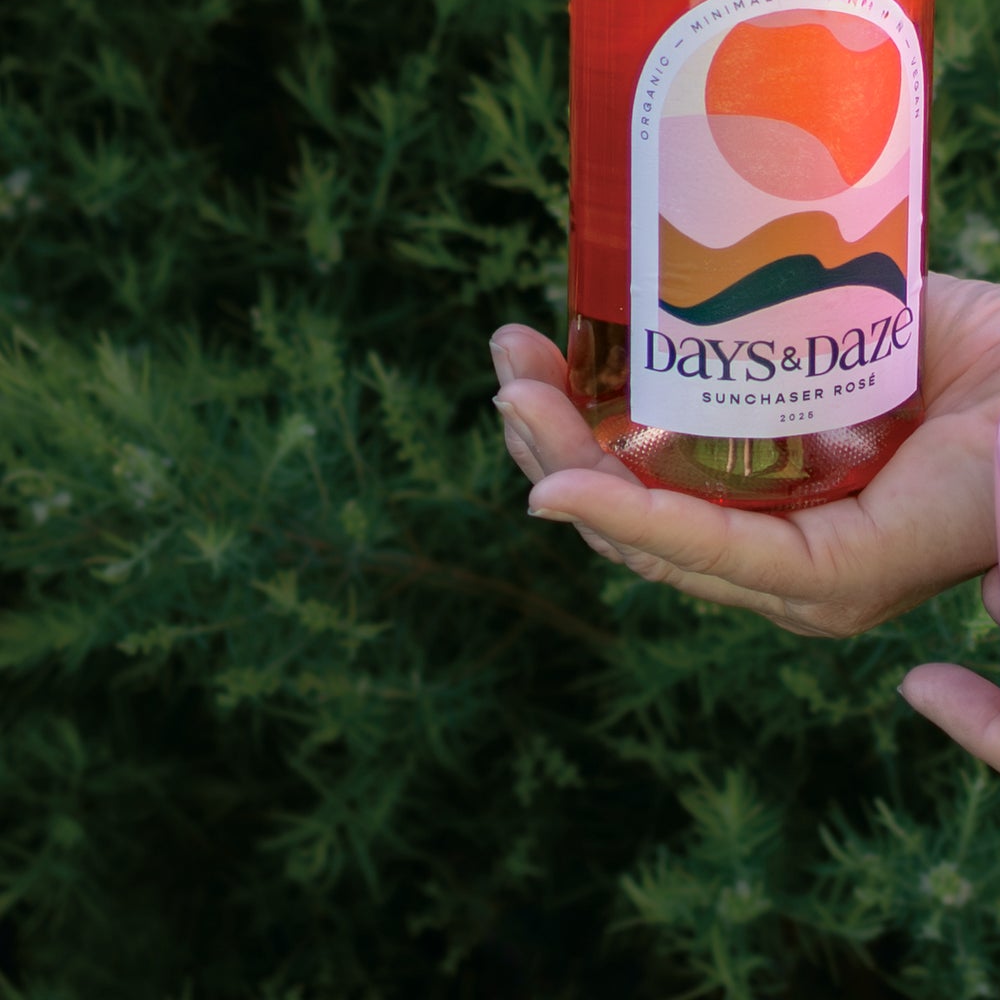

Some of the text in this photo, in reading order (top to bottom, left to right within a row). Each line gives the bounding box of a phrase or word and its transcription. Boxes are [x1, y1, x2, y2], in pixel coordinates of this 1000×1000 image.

[640, 55, 670, 141] ORGANIC
[702, 372, 876, 405] SUNCHASER ROSÉ
